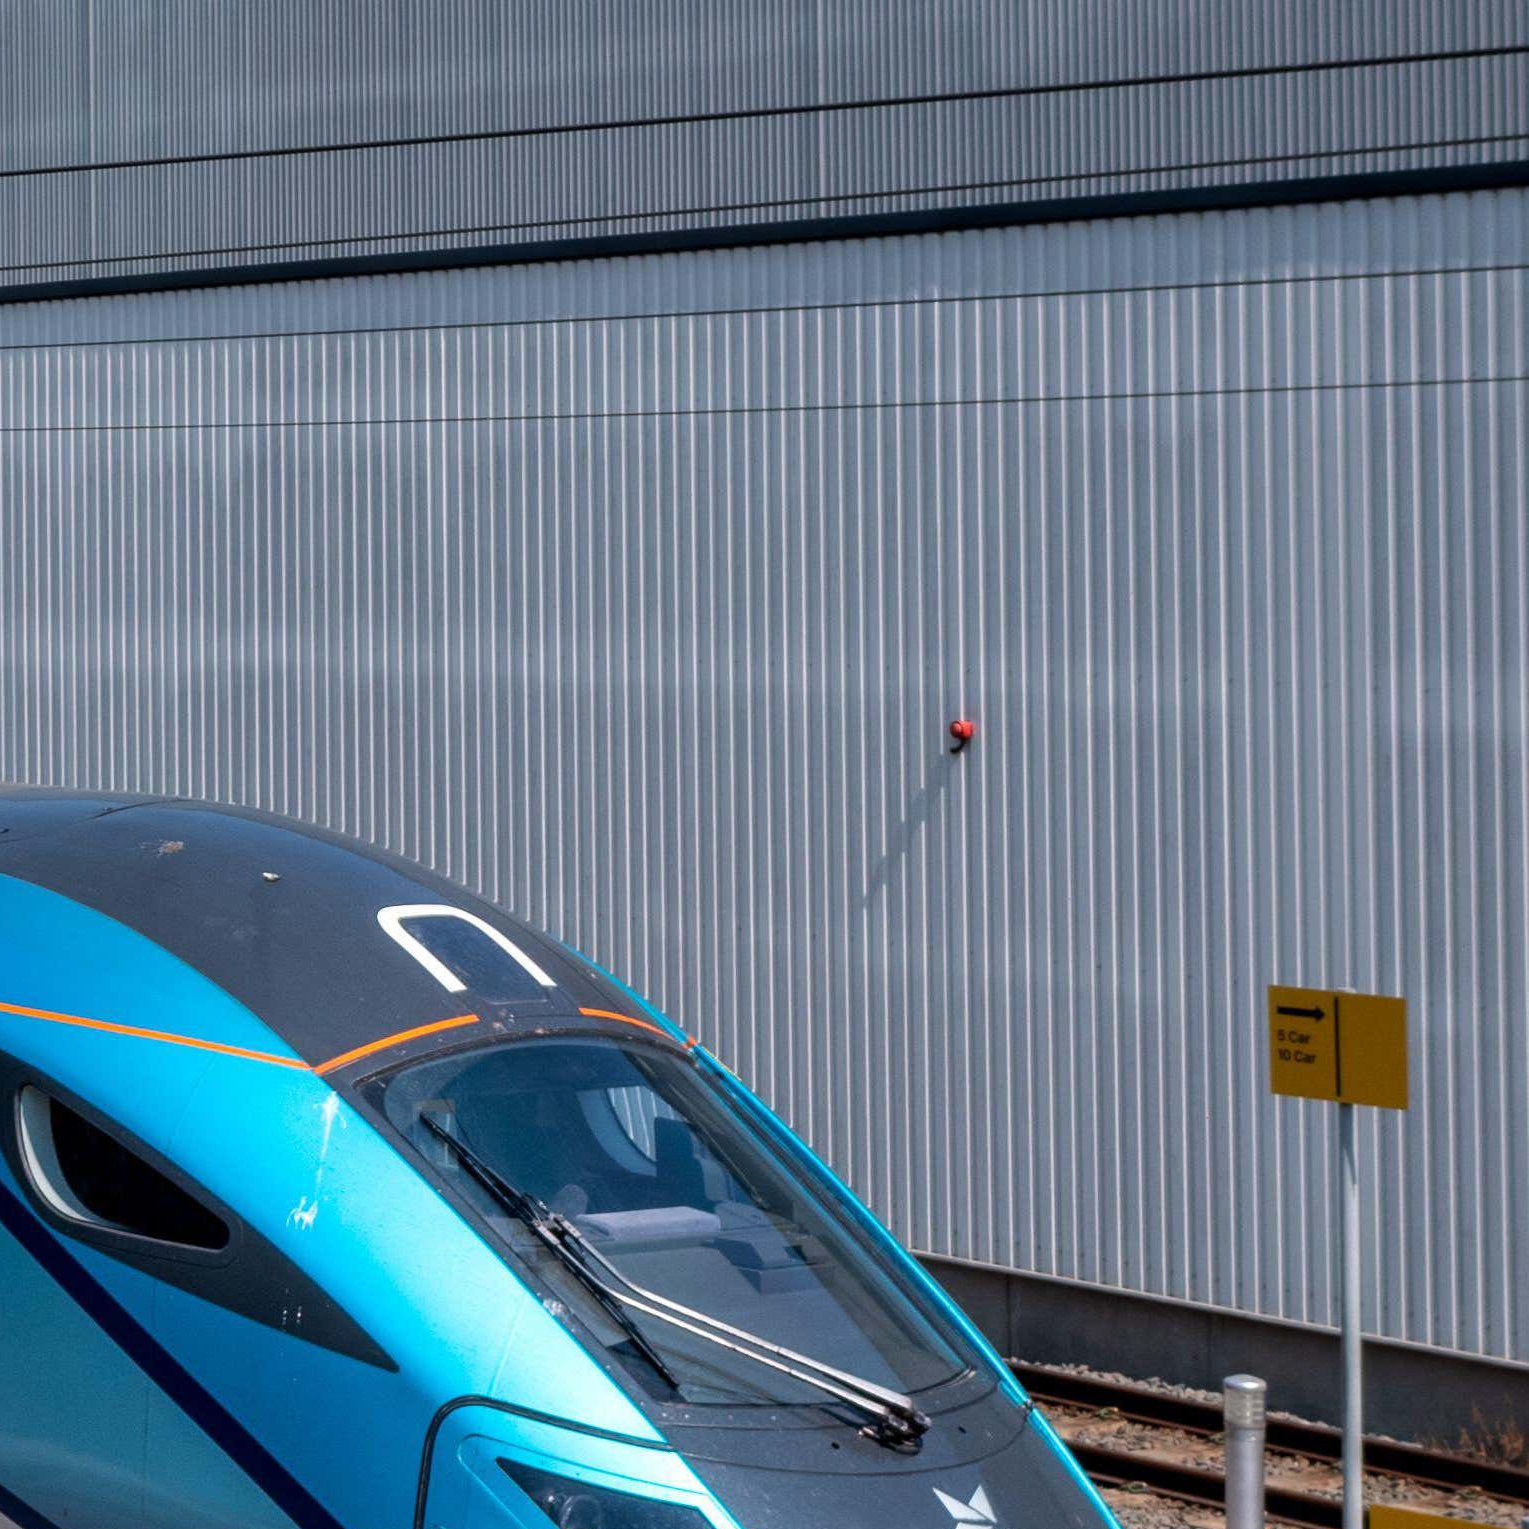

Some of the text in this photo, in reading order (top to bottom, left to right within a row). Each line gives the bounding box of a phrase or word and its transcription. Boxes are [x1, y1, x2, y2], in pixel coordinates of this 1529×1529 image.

[1277, 1029, 1311, 1045] 5 Car
[1277, 1048, 1317, 1065] 10 Car
